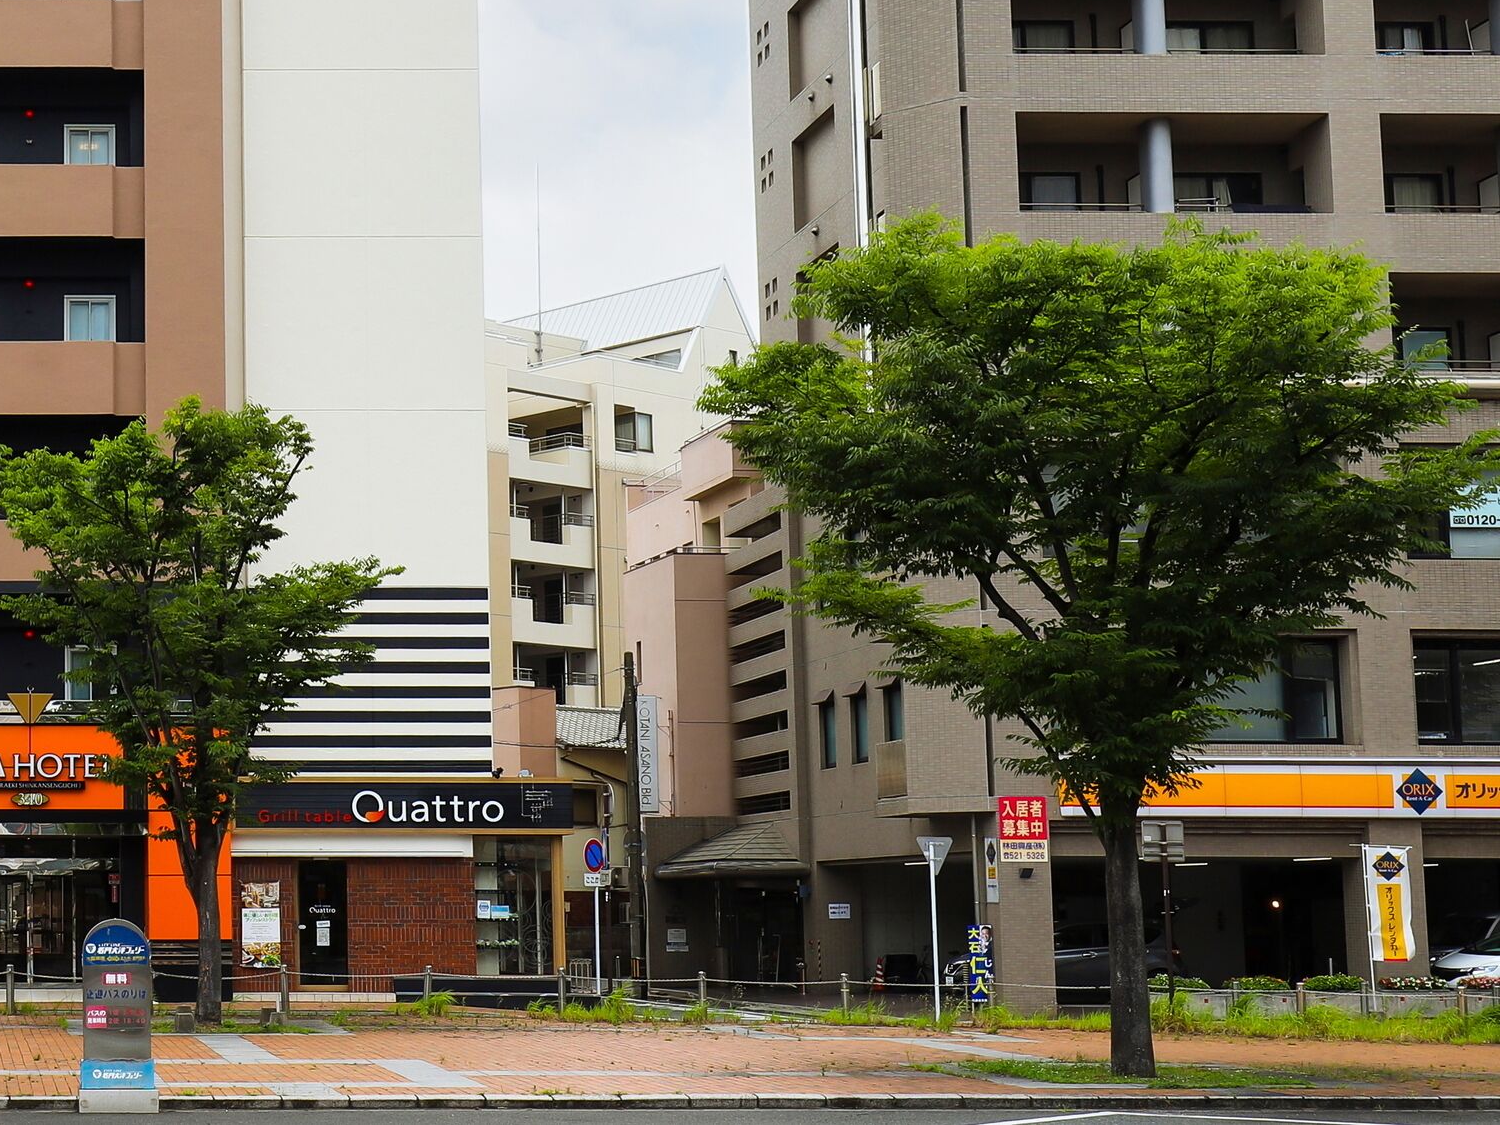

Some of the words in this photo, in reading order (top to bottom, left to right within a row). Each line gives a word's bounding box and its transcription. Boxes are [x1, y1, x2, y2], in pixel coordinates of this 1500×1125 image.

[639, 700, 651, 741] KOTANI
[640, 745, 652, 785] ASANO
[1402, 783, 1434, 795] ORIX
[1455, 783, 1500, 799] オリッ
[258, 810, 298, 823] Grill
[305, 810, 352, 823] table
[352, 789, 504, 823] Quattro
[1002, 800, 1043, 817] 入居者
[1002, 819, 1043, 837] 募集中
[1376, 861, 1399, 869] ORIX
[105, 974, 127, 984] 無料
